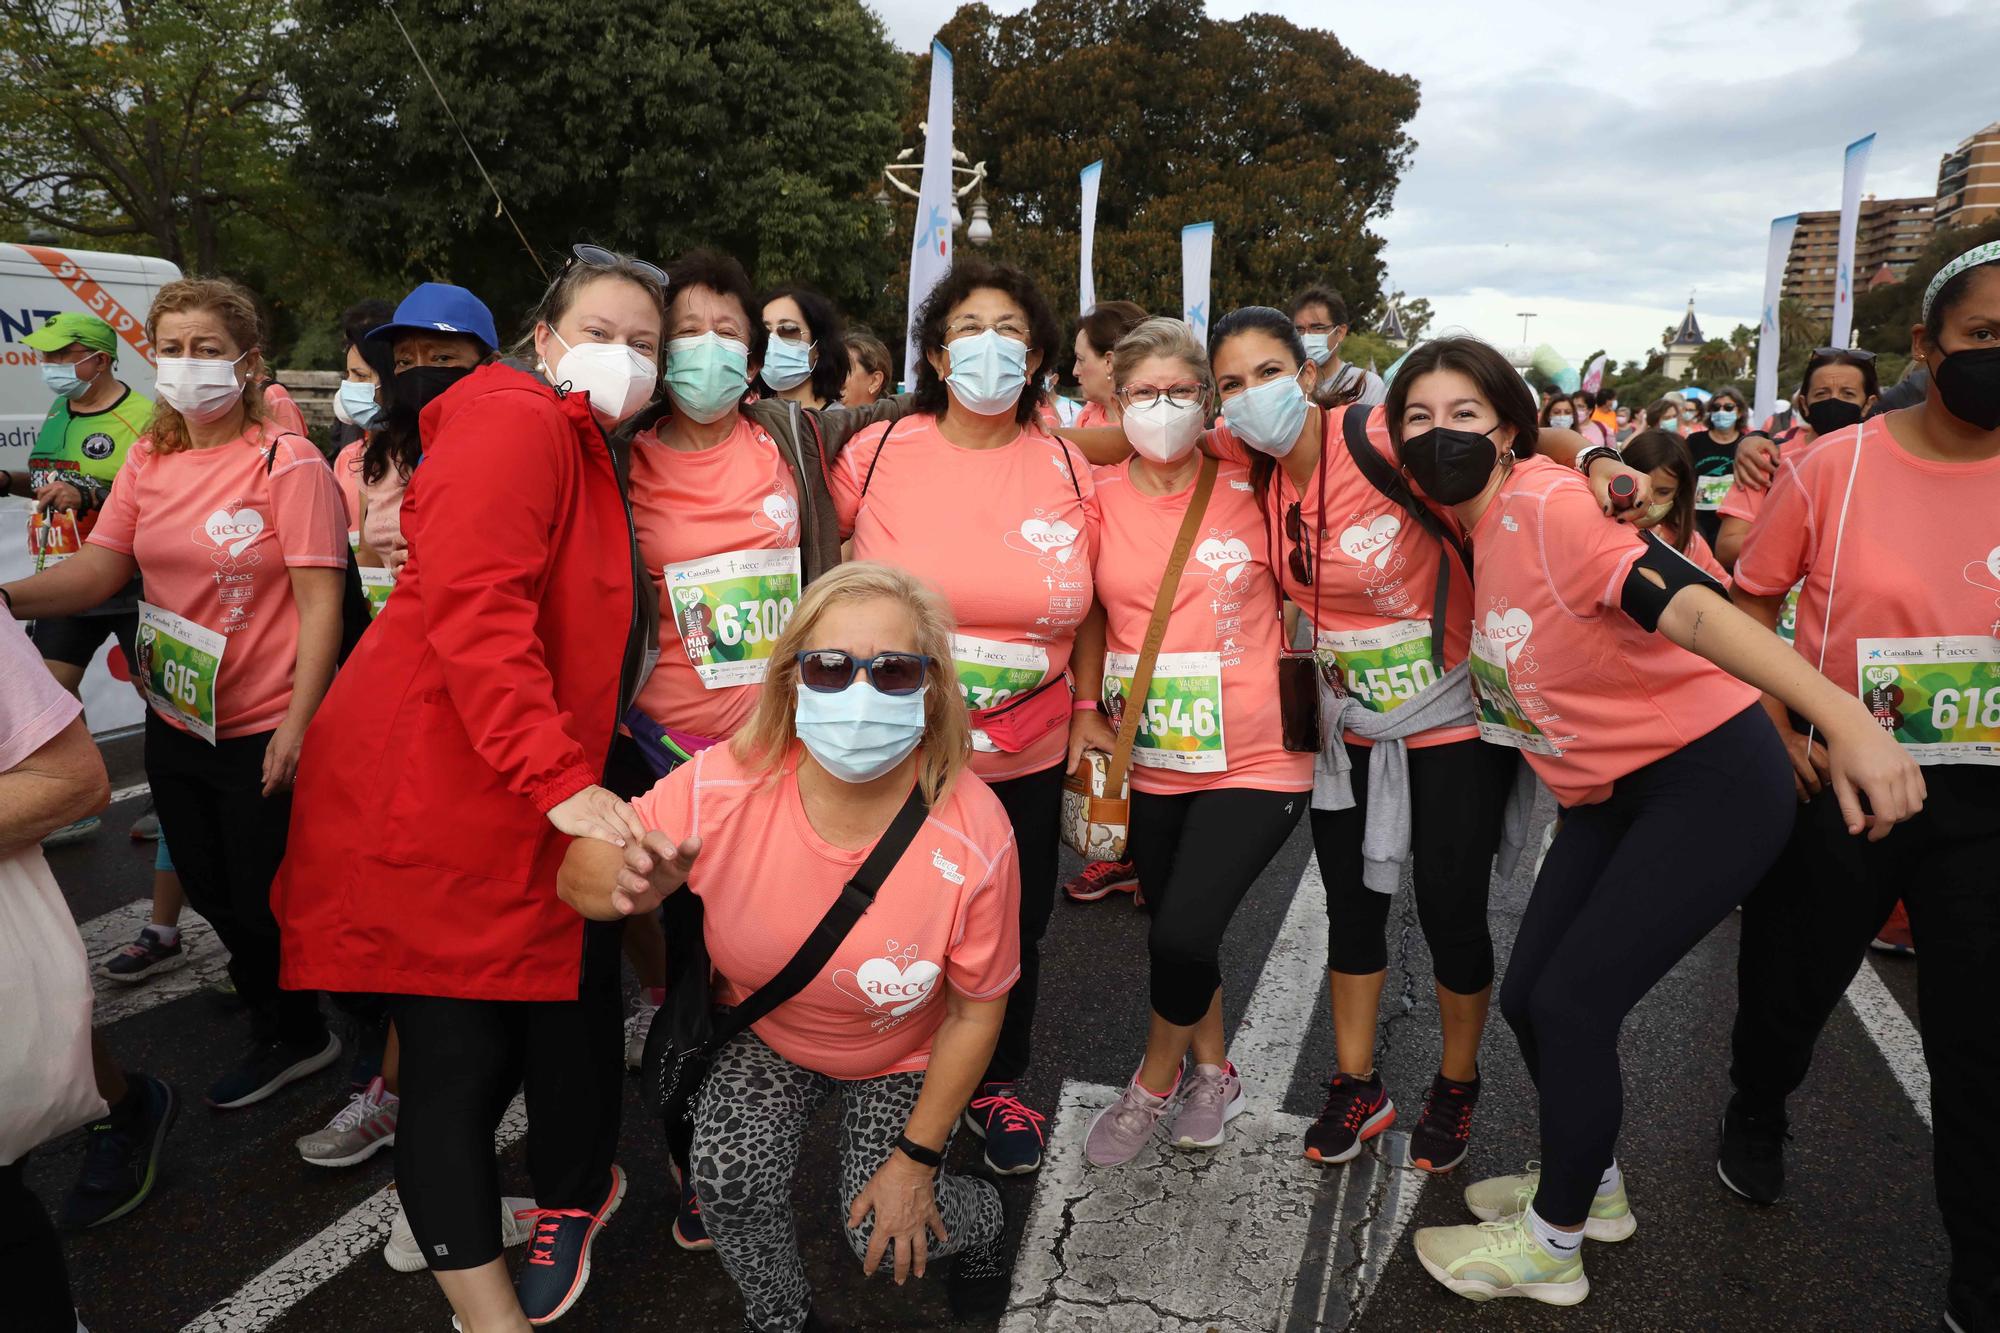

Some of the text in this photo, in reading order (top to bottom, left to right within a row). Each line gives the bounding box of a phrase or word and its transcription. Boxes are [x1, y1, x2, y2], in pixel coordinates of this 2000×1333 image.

[57, 261, 88, 291] 91
[88, 290, 134, 332] 519
[0, 351, 37, 366] ON
[0, 426, 40, 447] adri
[35, 526, 63, 547] 101
[211, 523, 258, 536] aecc
[1031, 532, 1076, 543] aecc
[1350, 528, 1396, 554] aecc
[1203, 550, 1248, 561] aecc
[687, 566, 721, 577] CaixaBank
[740, 562, 760, 570] aecc
[225, 573, 254, 582] aecc
[1378, 577, 1403, 594] aecc
[1489, 624, 1528, 639] aecc
[687, 635, 709, 648] MAR
[689, 647, 711, 659] CHA
[984, 652, 1007, 661] aecc
[1883, 649, 1924, 657] CaixaBank
[1946, 648, 1978, 656] aecc
[164, 659, 199, 705] 615
[1179, 679, 1210, 687] VALENCIA
[1348, 659, 1438, 702] 4550
[1872, 688, 1884, 717] RUN AECC
[1931, 686, 2000, 730] 618
[866, 980, 931, 997] aecc
